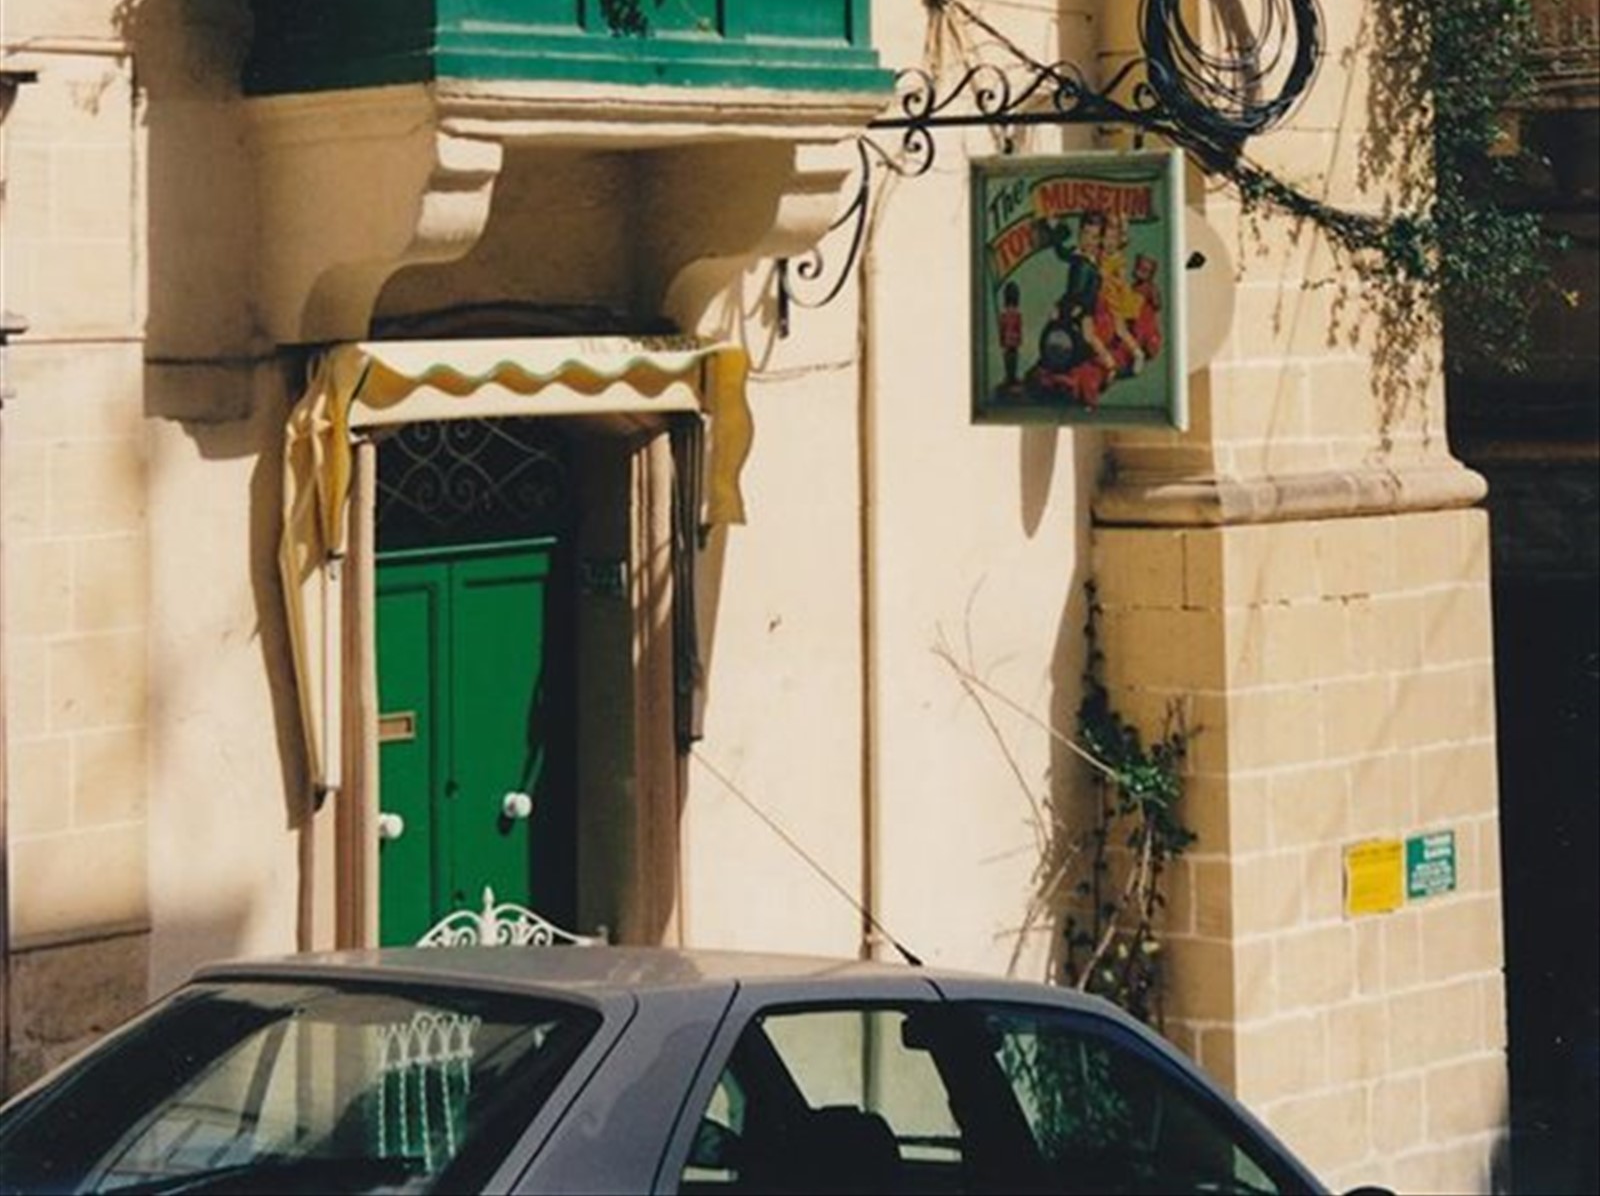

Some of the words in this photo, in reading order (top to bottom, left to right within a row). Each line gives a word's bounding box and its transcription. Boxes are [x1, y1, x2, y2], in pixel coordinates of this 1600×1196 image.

[990, 179, 1024, 229] The
[1041, 182, 1150, 216] MUSEUM
[997, 223, 1032, 267] TOY
